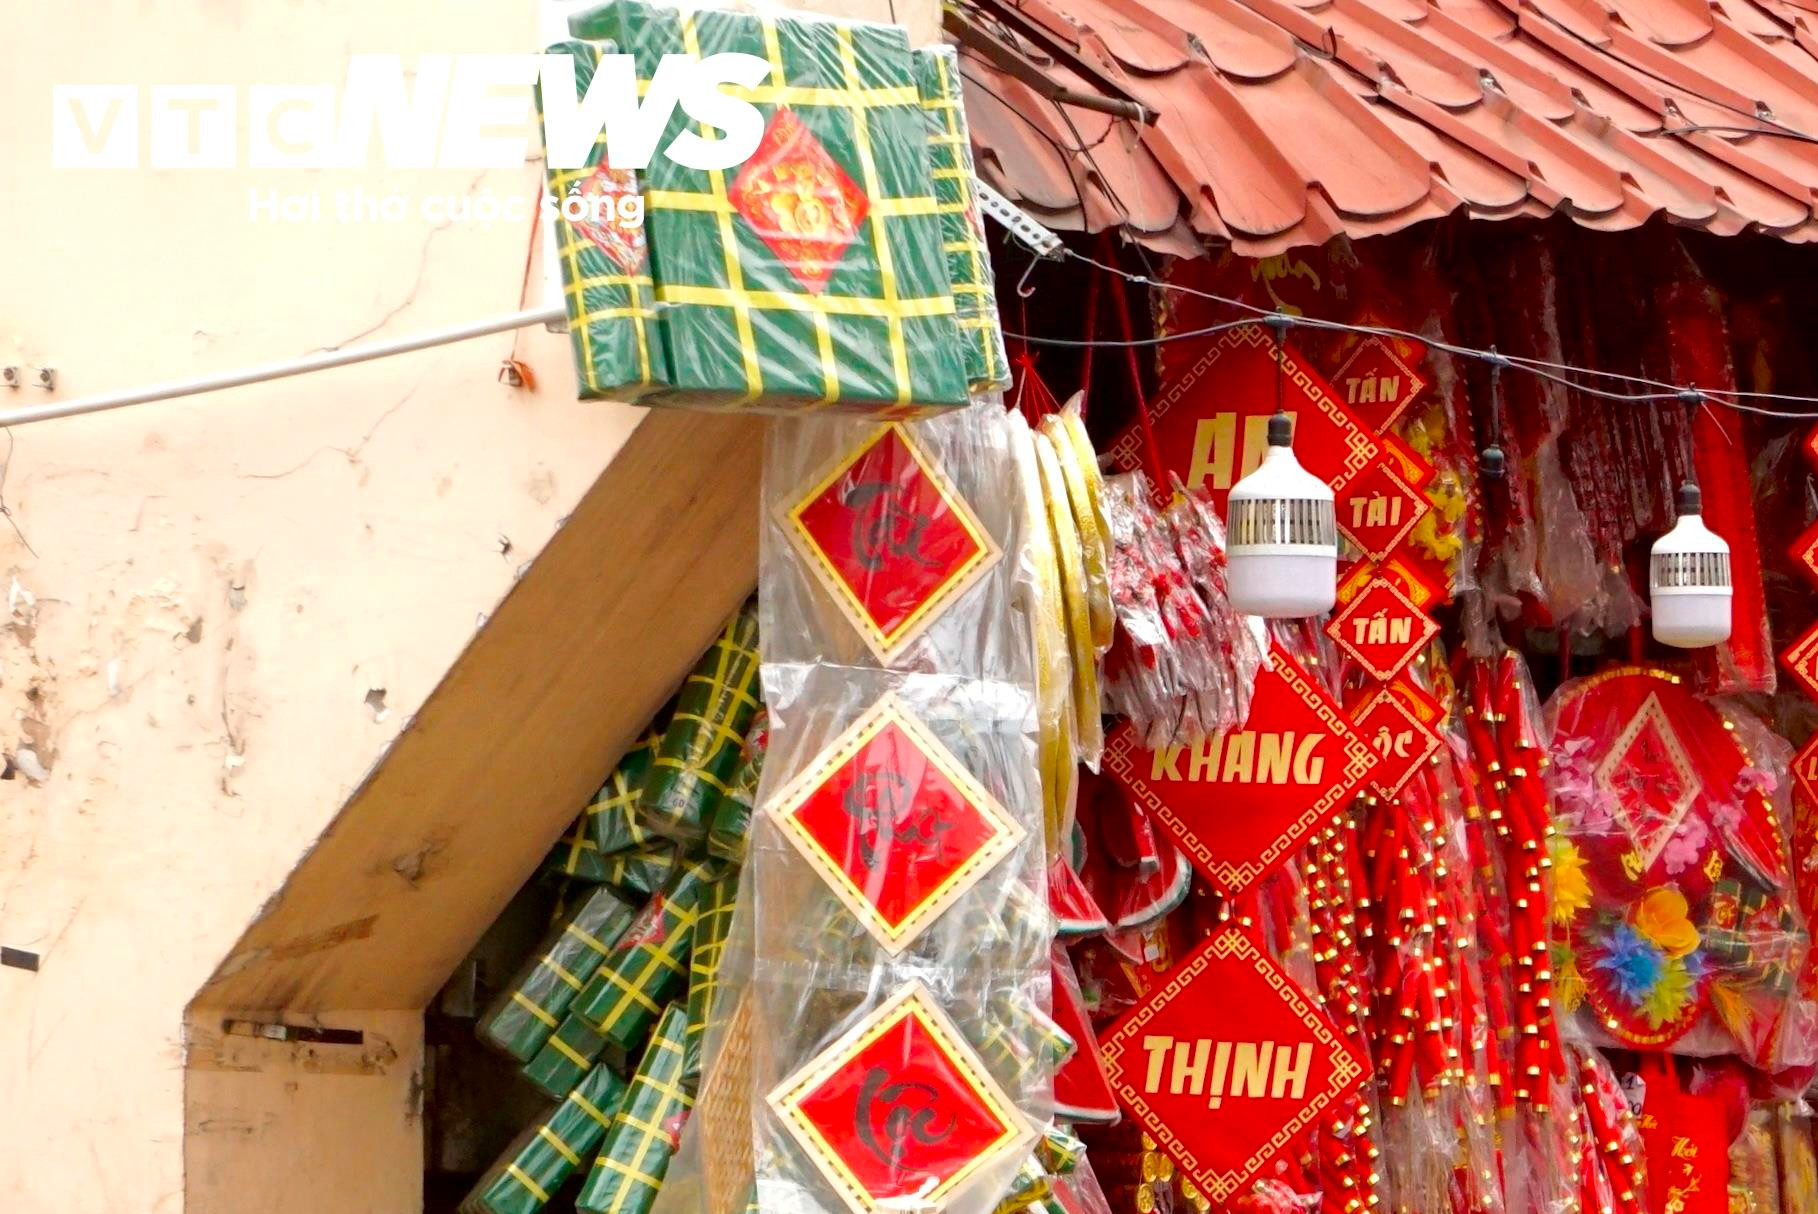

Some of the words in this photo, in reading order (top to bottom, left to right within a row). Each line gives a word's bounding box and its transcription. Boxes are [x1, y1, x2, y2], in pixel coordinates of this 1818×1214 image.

[1346, 367, 1400, 404] TẤN
[1350, 496, 1401, 528] TÀI
[1353, 608, 1413, 645] TẤN
[1149, 730, 1326, 785] KHANG
[1374, 726, 1414, 762] ỘC
[1143, 1035, 1313, 1110] THỊNH
